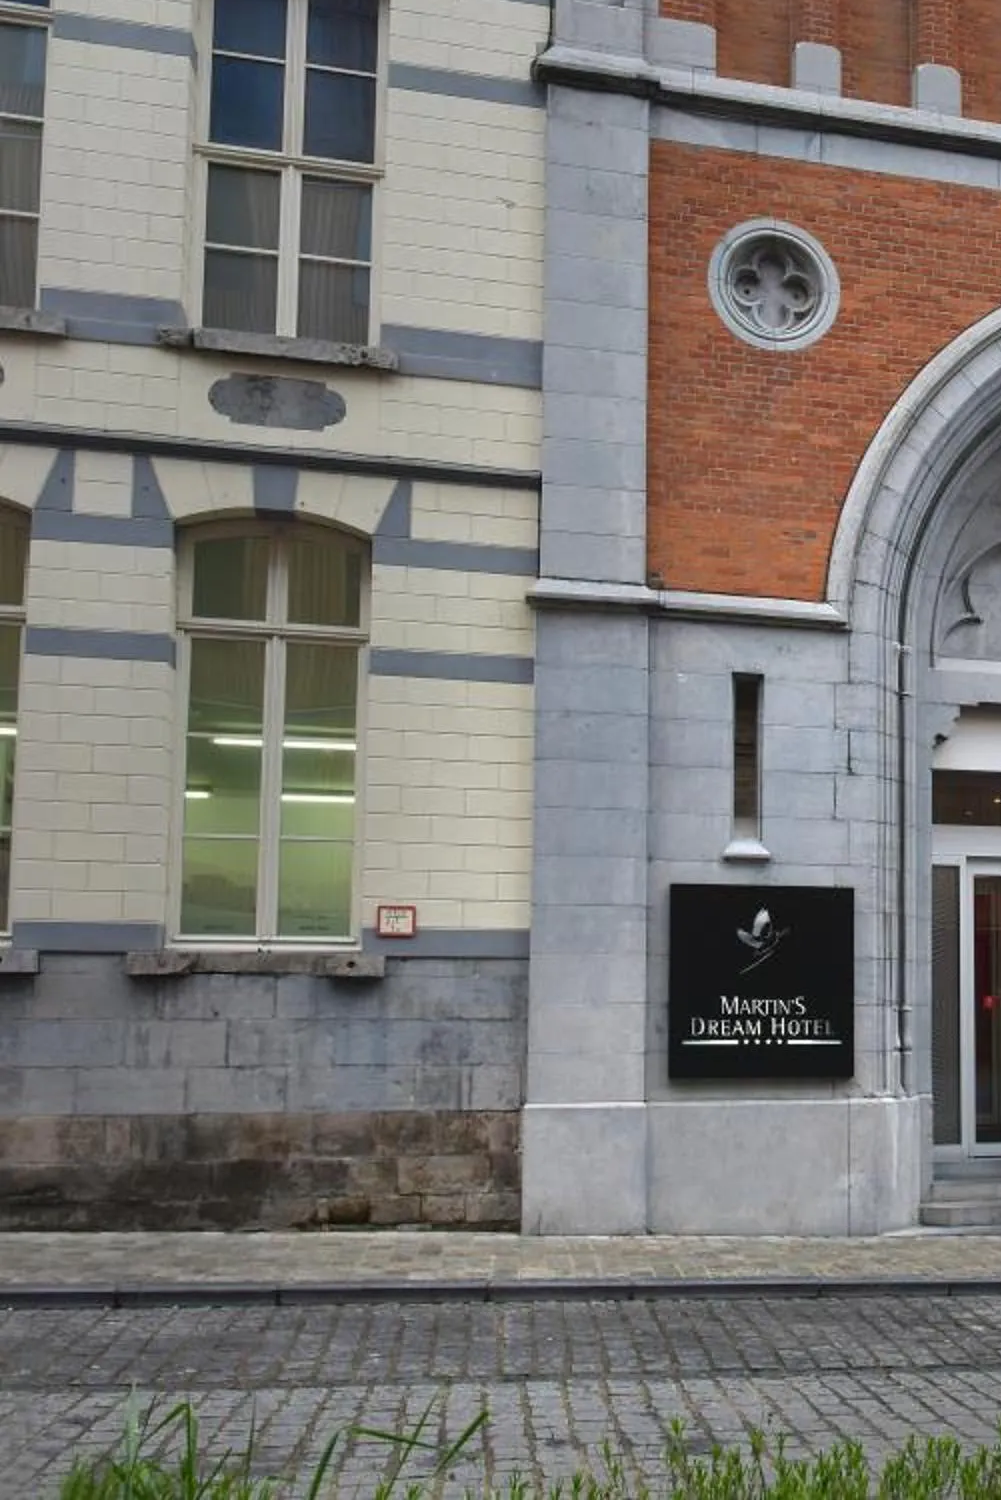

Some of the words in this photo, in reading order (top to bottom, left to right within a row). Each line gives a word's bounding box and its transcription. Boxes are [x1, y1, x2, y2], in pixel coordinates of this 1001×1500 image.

[720, 995, 807, 1016] MARTIN'S
[691, 1017, 761, 1036] DREAM
[771, 1017, 833, 1036] HOTEL
